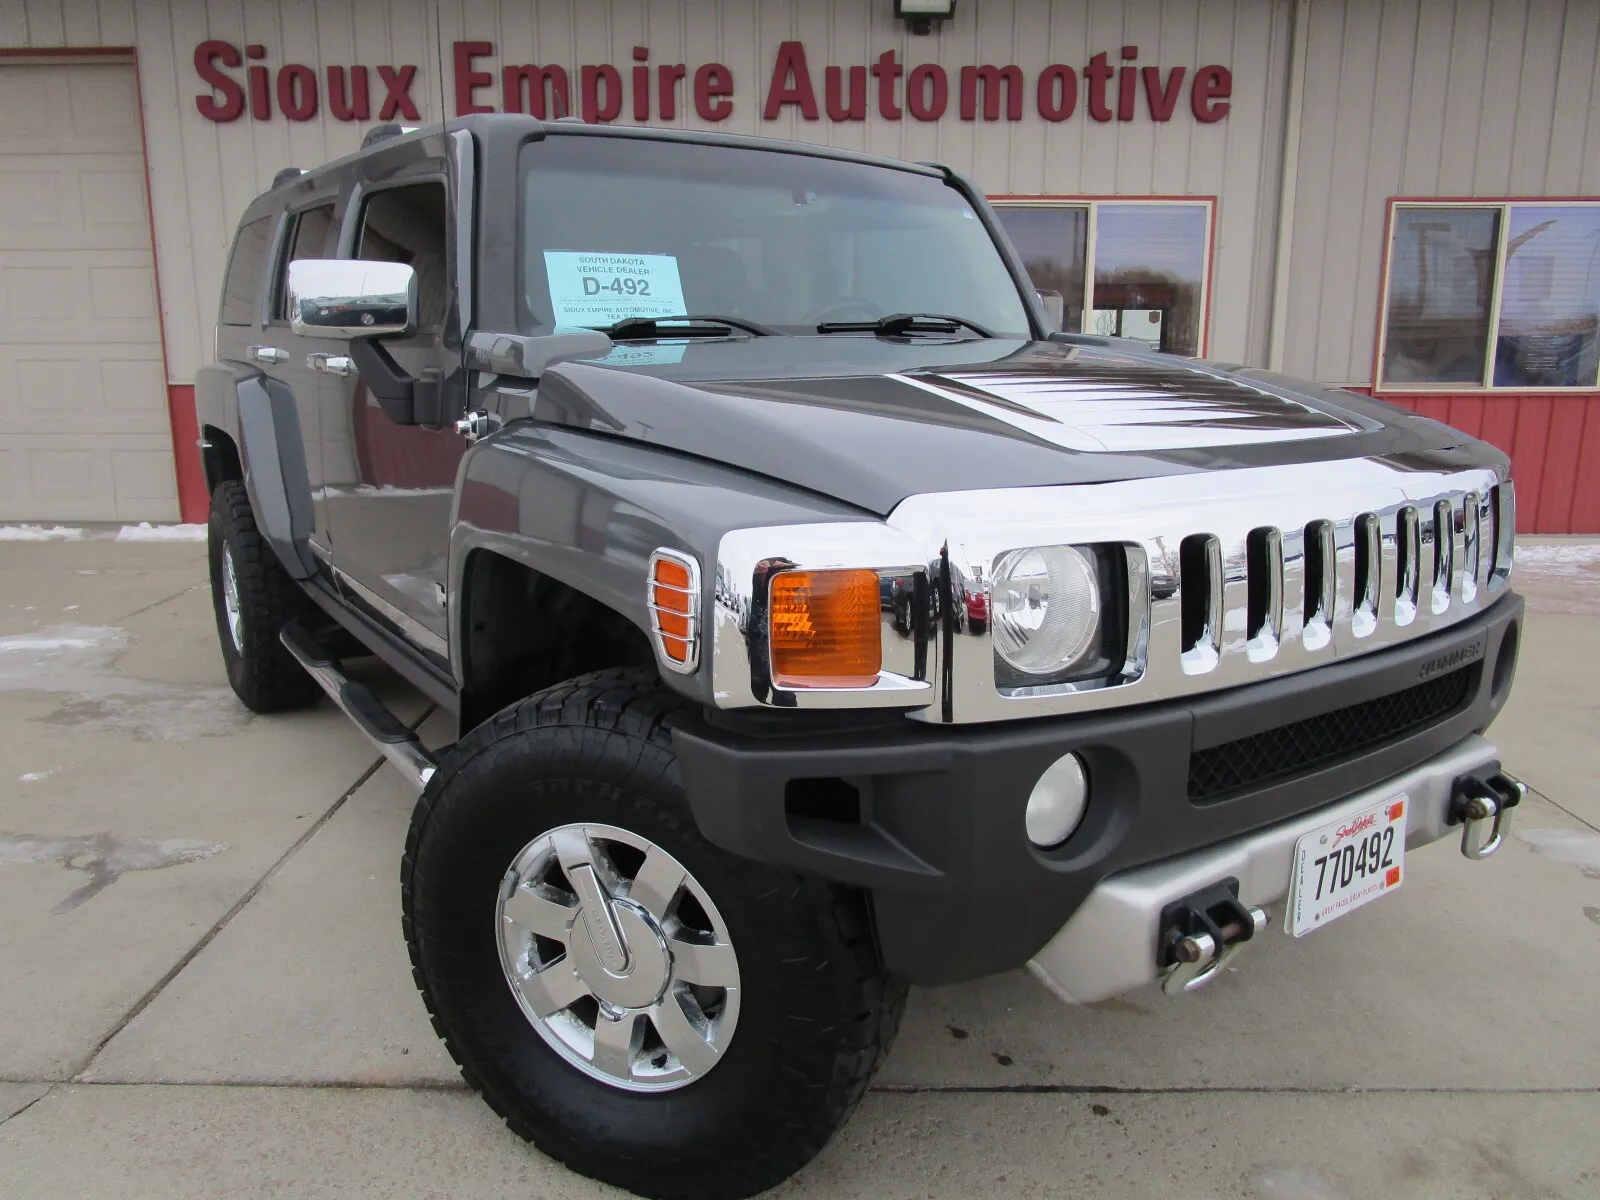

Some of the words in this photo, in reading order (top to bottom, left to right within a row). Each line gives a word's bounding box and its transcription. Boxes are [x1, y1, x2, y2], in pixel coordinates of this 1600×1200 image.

[193, 40, 423, 123] Sioux
[453, 41, 735, 126] Empire
[763, 41, 1232, 123] Automotive
[576, 265, 614, 274] VEHICLE
[616, 266, 650, 276] DEALER
[578, 256, 609, 264] SOUTH
[610, 257, 645, 266] DAKOTA
[582, 276, 651, 297] D-492
[1297, 849, 1306, 923] DEALER
[1314, 826, 1395, 901] 77D492
